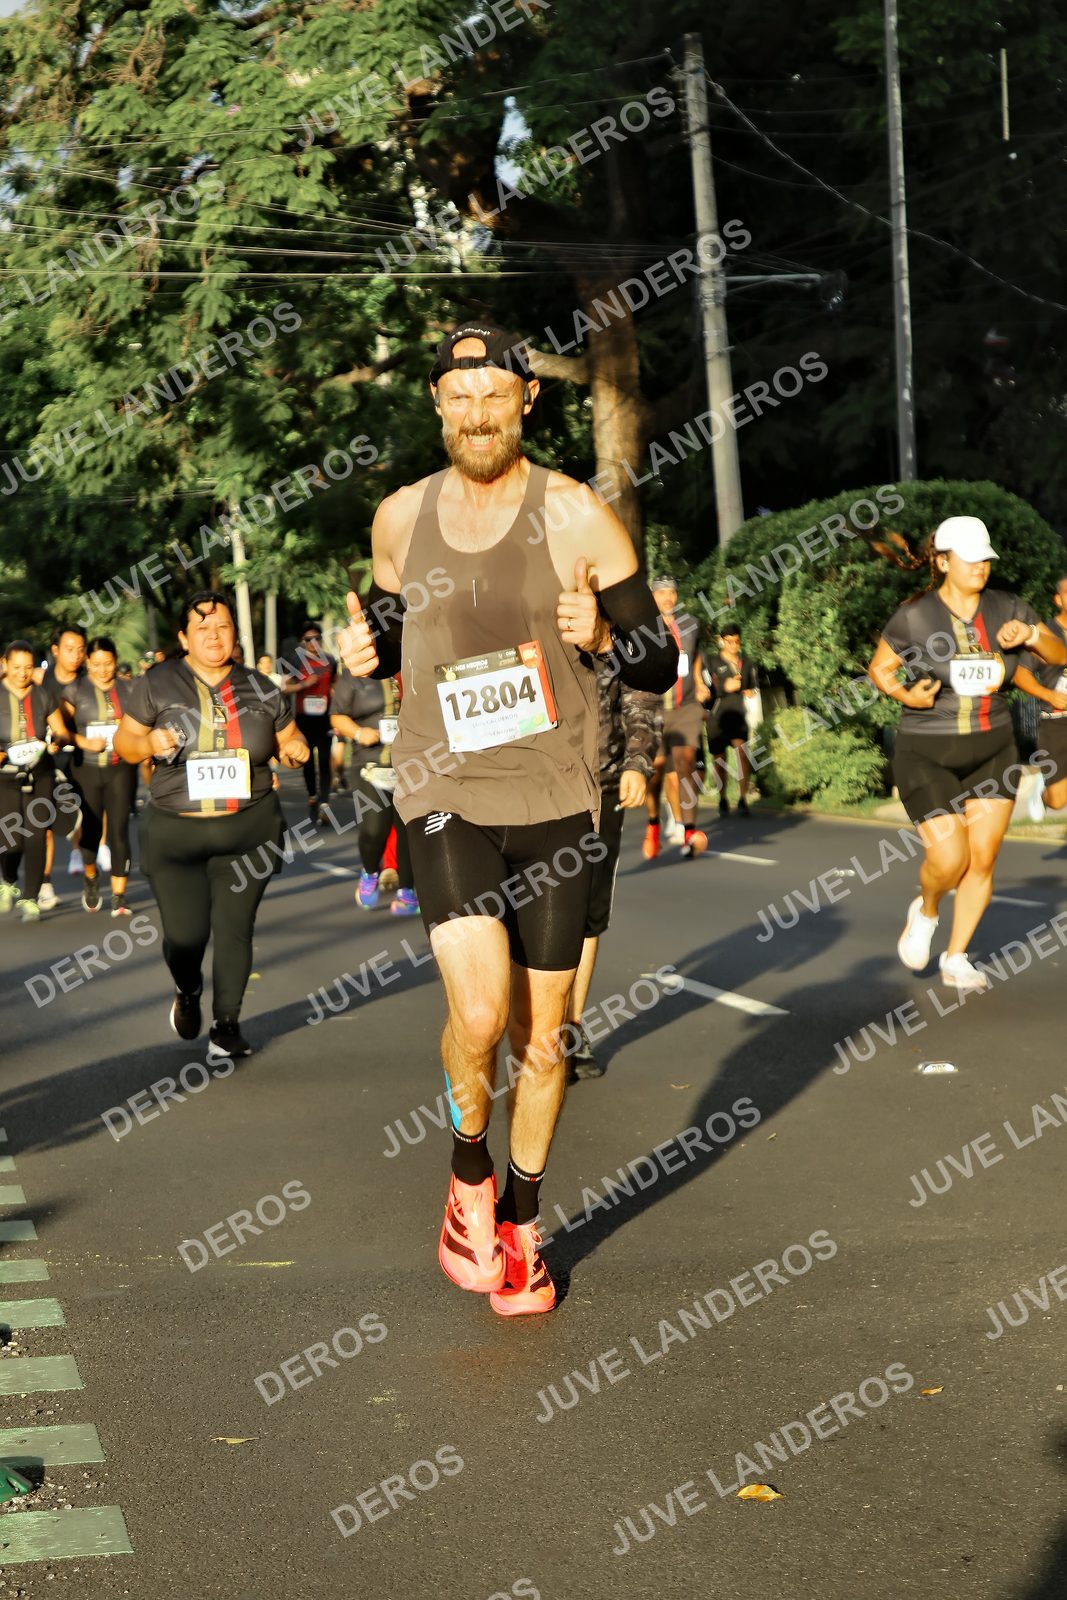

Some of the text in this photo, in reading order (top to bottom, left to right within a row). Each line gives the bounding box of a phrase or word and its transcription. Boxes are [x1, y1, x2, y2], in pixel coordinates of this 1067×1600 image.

[958, 666, 992, 681] 4781
[445, 675, 537, 721] 12804
[197, 765, 237, 781] 5170
